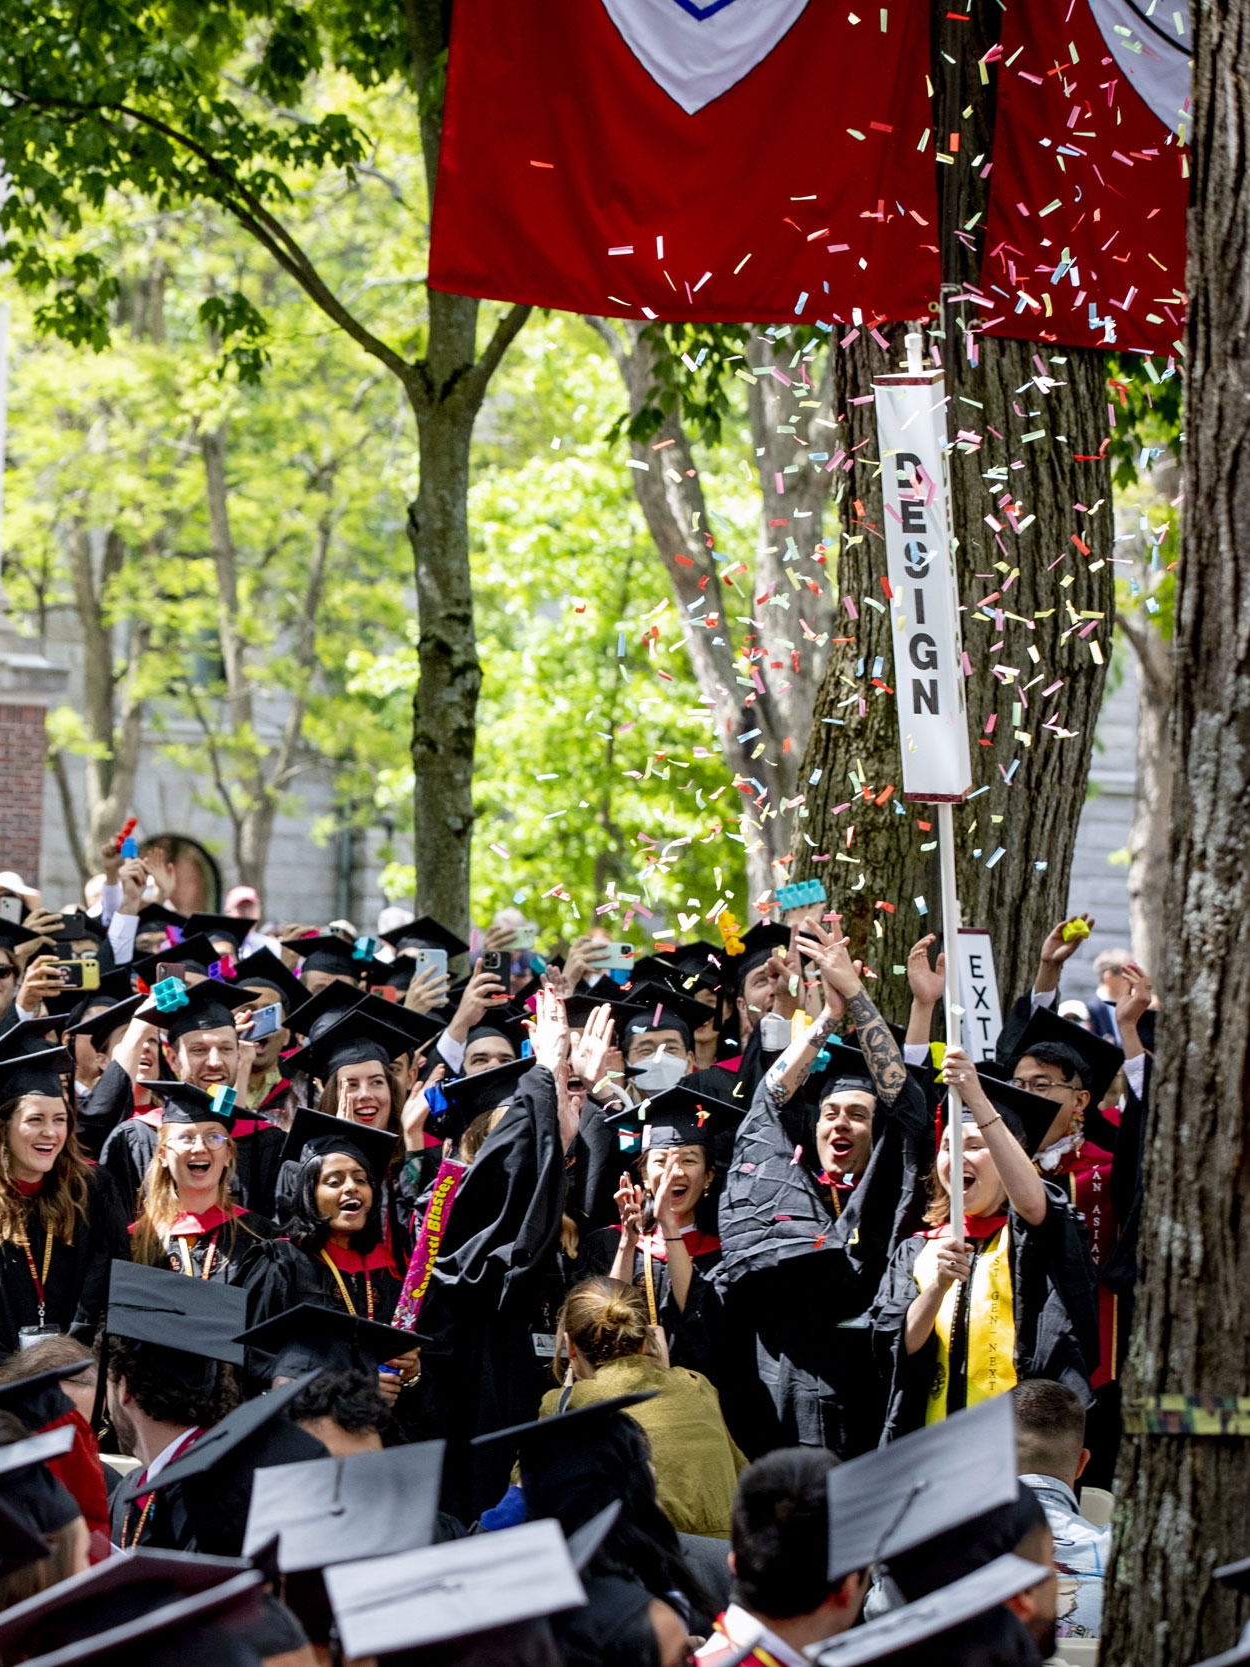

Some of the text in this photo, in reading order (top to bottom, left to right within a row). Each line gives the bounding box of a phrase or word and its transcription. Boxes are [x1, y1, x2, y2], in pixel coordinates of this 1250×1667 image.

[897, 452, 940, 715] DESIGN
[411, 1175, 456, 1299] Confetti Blaster
[1091, 1164, 1102, 1266] AN ASIAN
[366, 1280, 374, 1313] HARVARD
